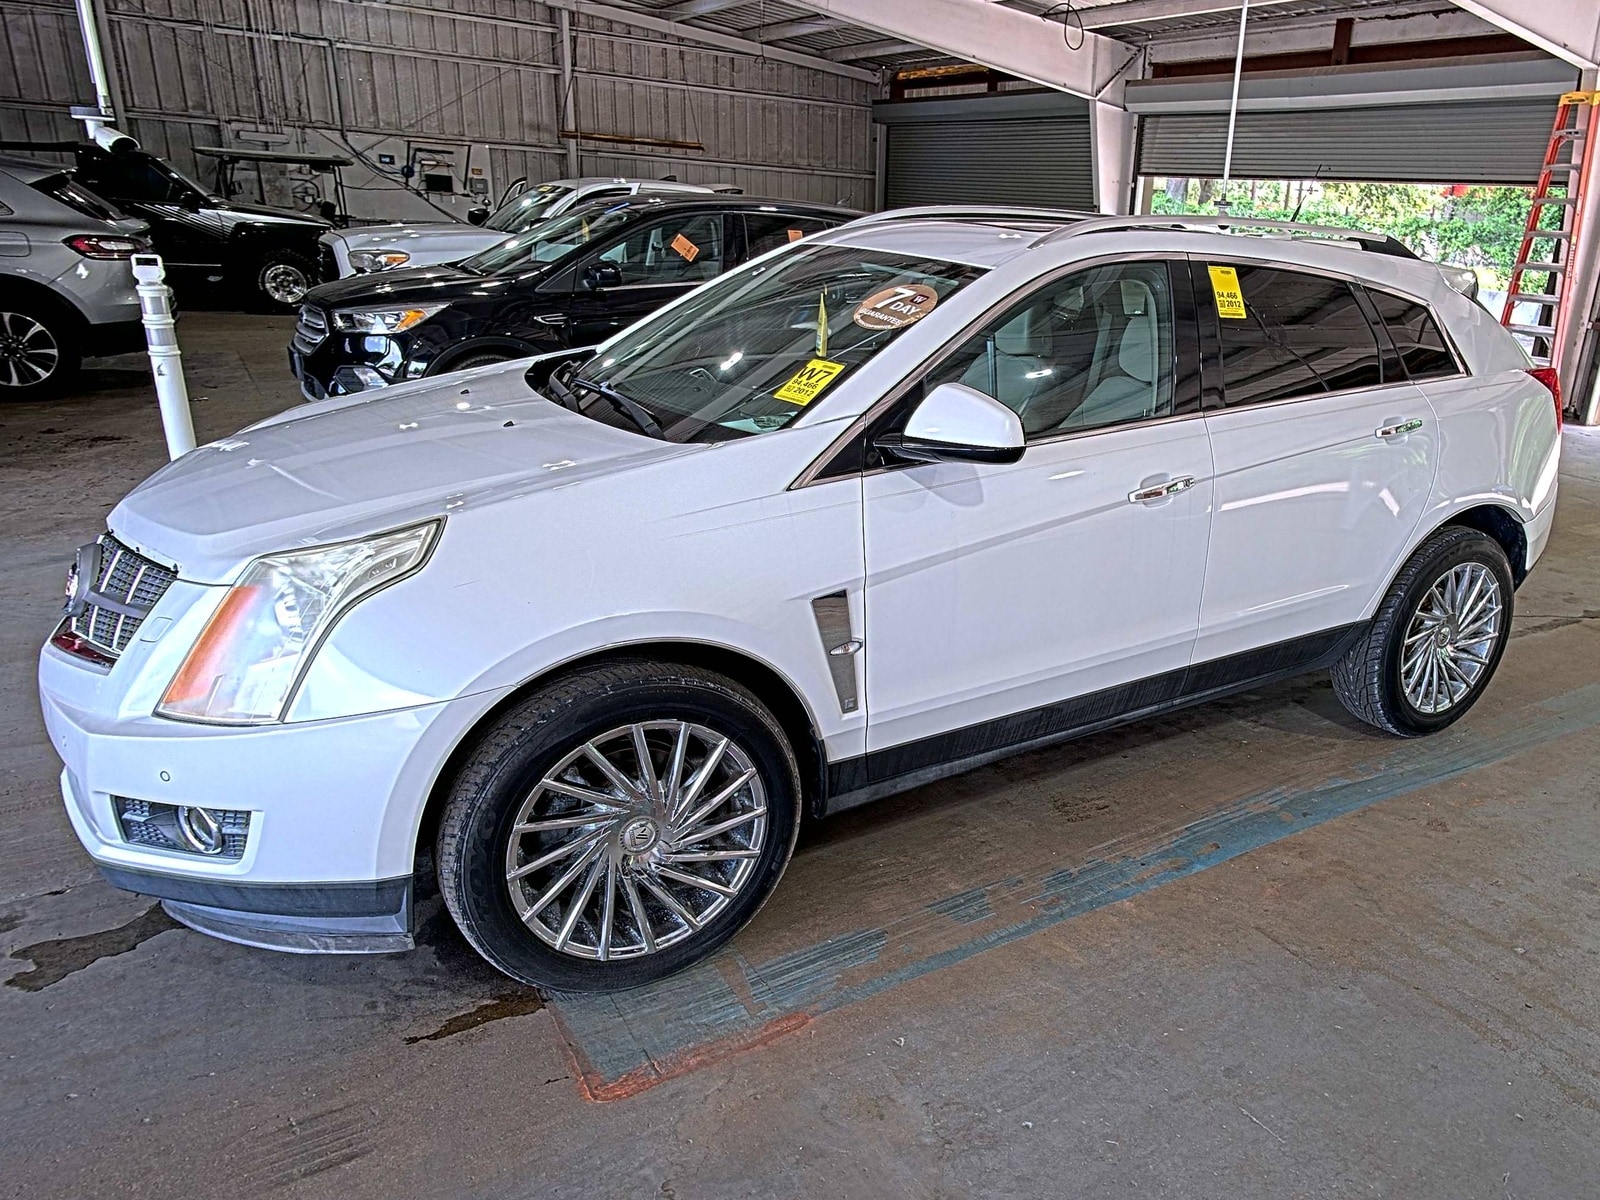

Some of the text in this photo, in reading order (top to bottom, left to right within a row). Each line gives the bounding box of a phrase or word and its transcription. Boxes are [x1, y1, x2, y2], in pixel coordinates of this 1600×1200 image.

[874, 287, 917, 309] 7
[913, 295, 928, 304] W
[858, 307, 905, 326] GUARANTEE
[889, 301, 922, 316] DAY
[797, 367, 834, 384] W7
[793, 387, 815, 397] 2012
